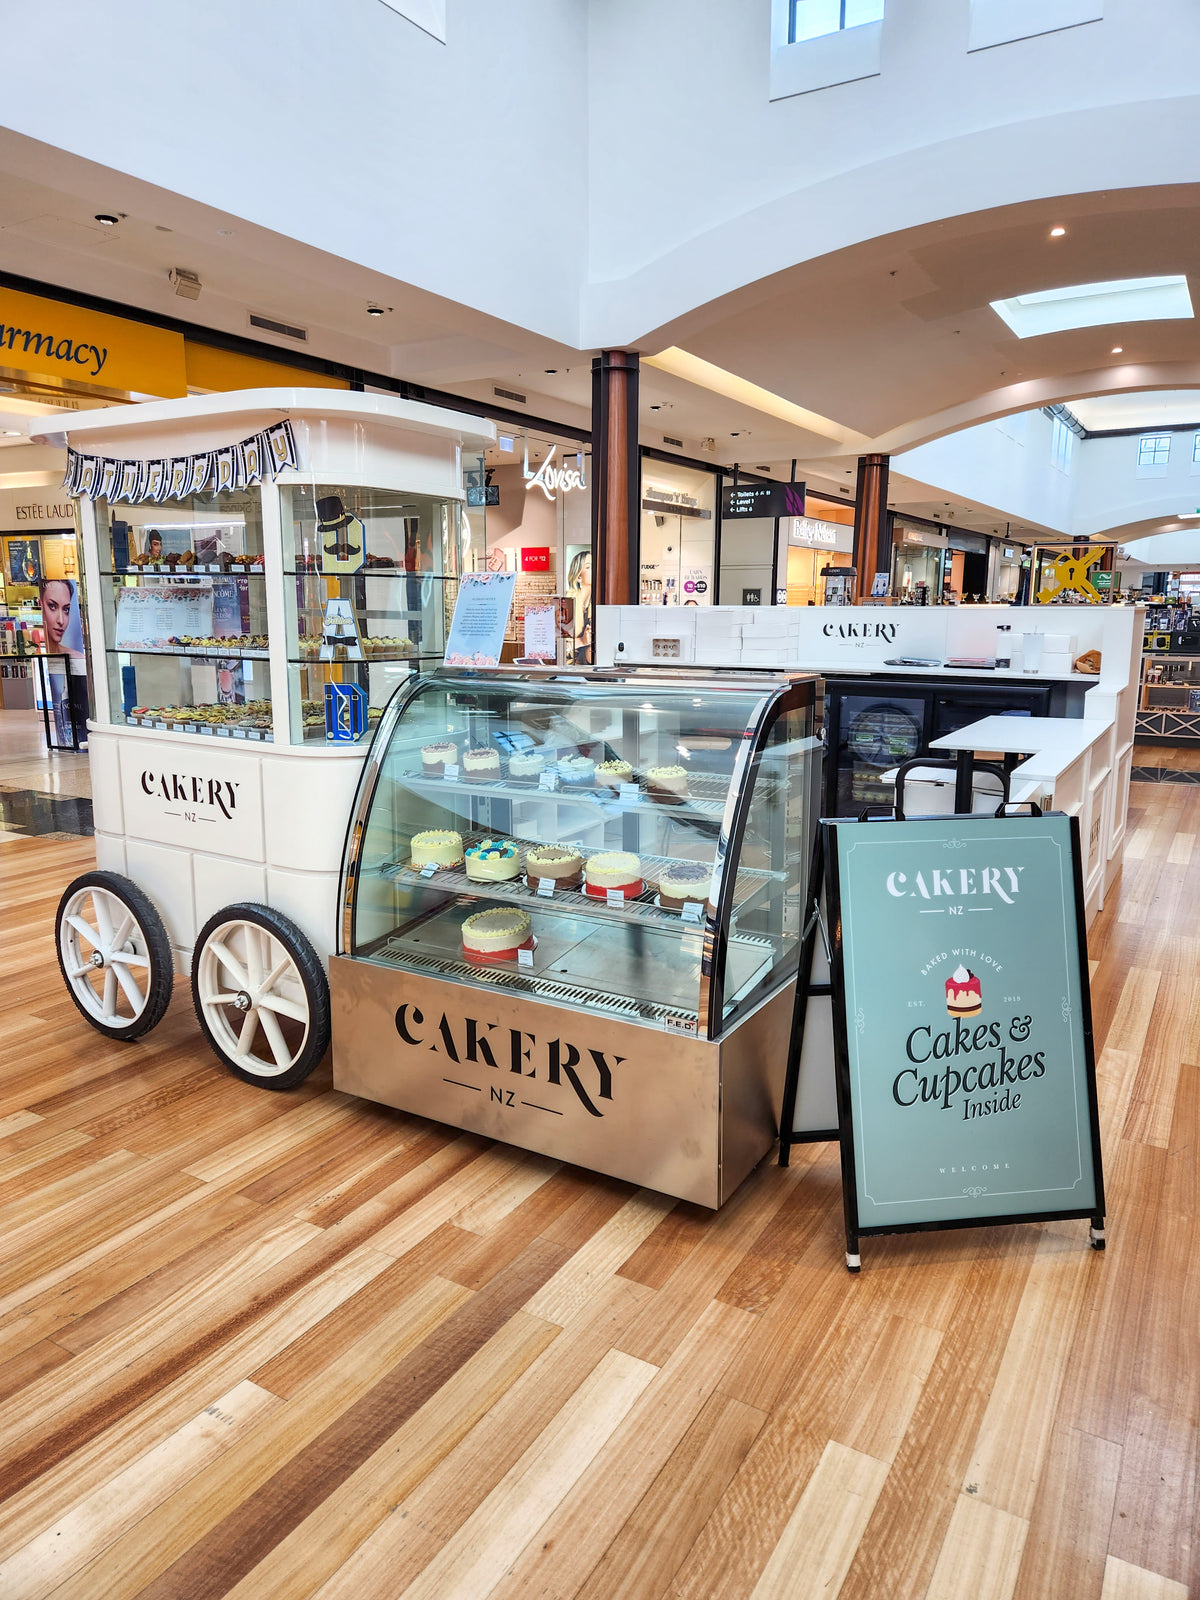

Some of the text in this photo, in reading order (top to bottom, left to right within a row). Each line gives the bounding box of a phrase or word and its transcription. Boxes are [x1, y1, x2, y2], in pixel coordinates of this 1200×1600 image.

[525, 444, 587, 501] Lovisa
[822, 623, 900, 644] CAKERY
[141, 769, 240, 820] CAKERY
[184, 811, 197, 823] NZ
[886, 866, 1025, 905] CAKERY
[949, 906, 964, 915] NZ
[920, 948, 1003, 976] BAKED WITH LOVE
[905, 1015, 1033, 1064] Cakes &
[394, 1003, 628, 1118] CAKERY
[892, 1046, 1047, 1110] Cupcakes
[489, 1085, 516, 1108] NZ
[962, 1088, 1022, 1121] Inside
[939, 1162, 1011, 1174] WELCOME
